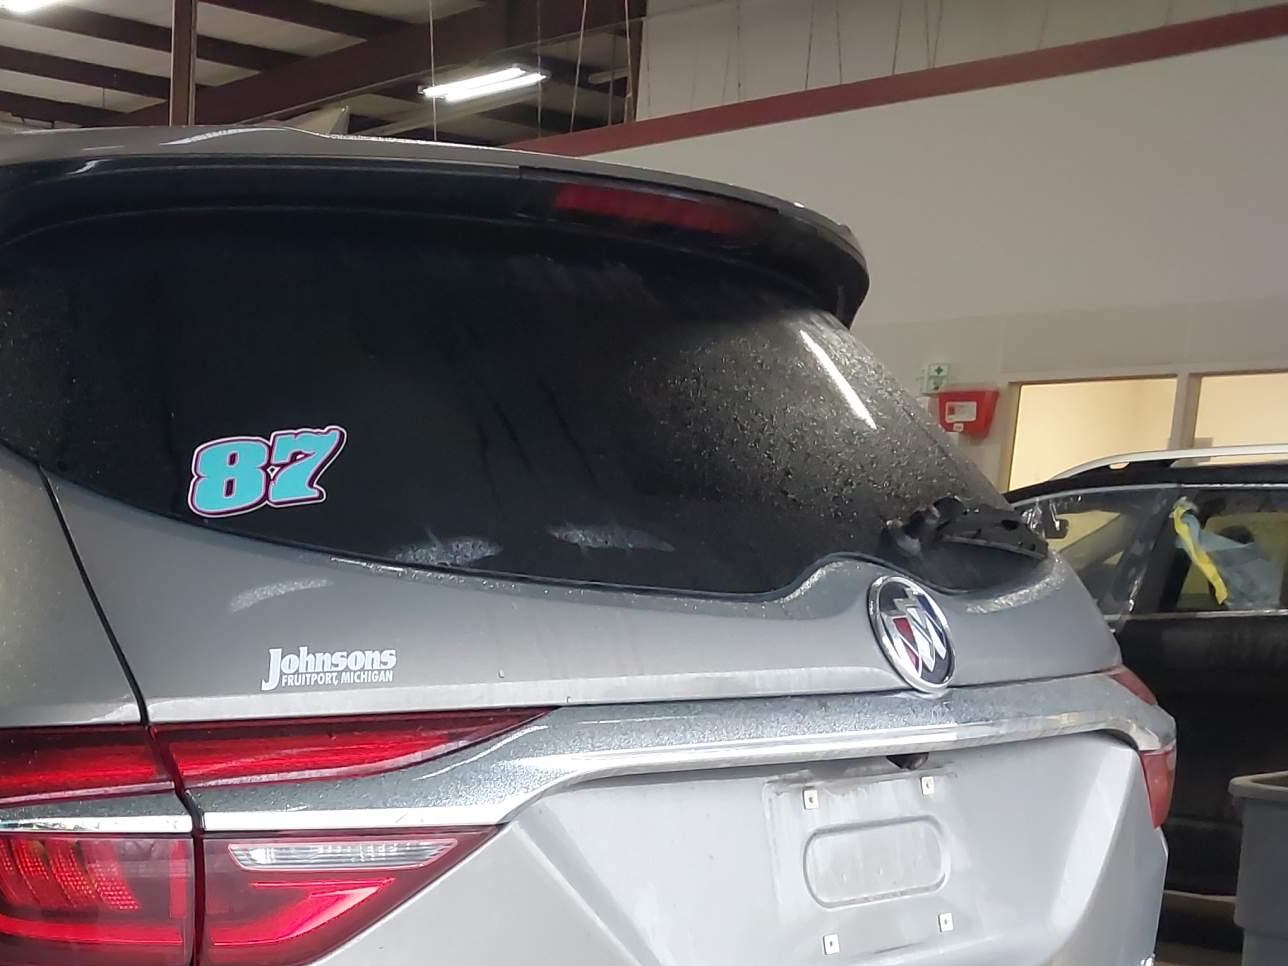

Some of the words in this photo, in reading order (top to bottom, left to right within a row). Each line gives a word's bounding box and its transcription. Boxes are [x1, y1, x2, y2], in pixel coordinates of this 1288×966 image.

[188, 425, 347, 518] 87
[261, 646, 397, 691] Johnsons
[282, 672, 337, 687] FRUITPORT,
[340, 670, 393, 684] MICHIGAN
